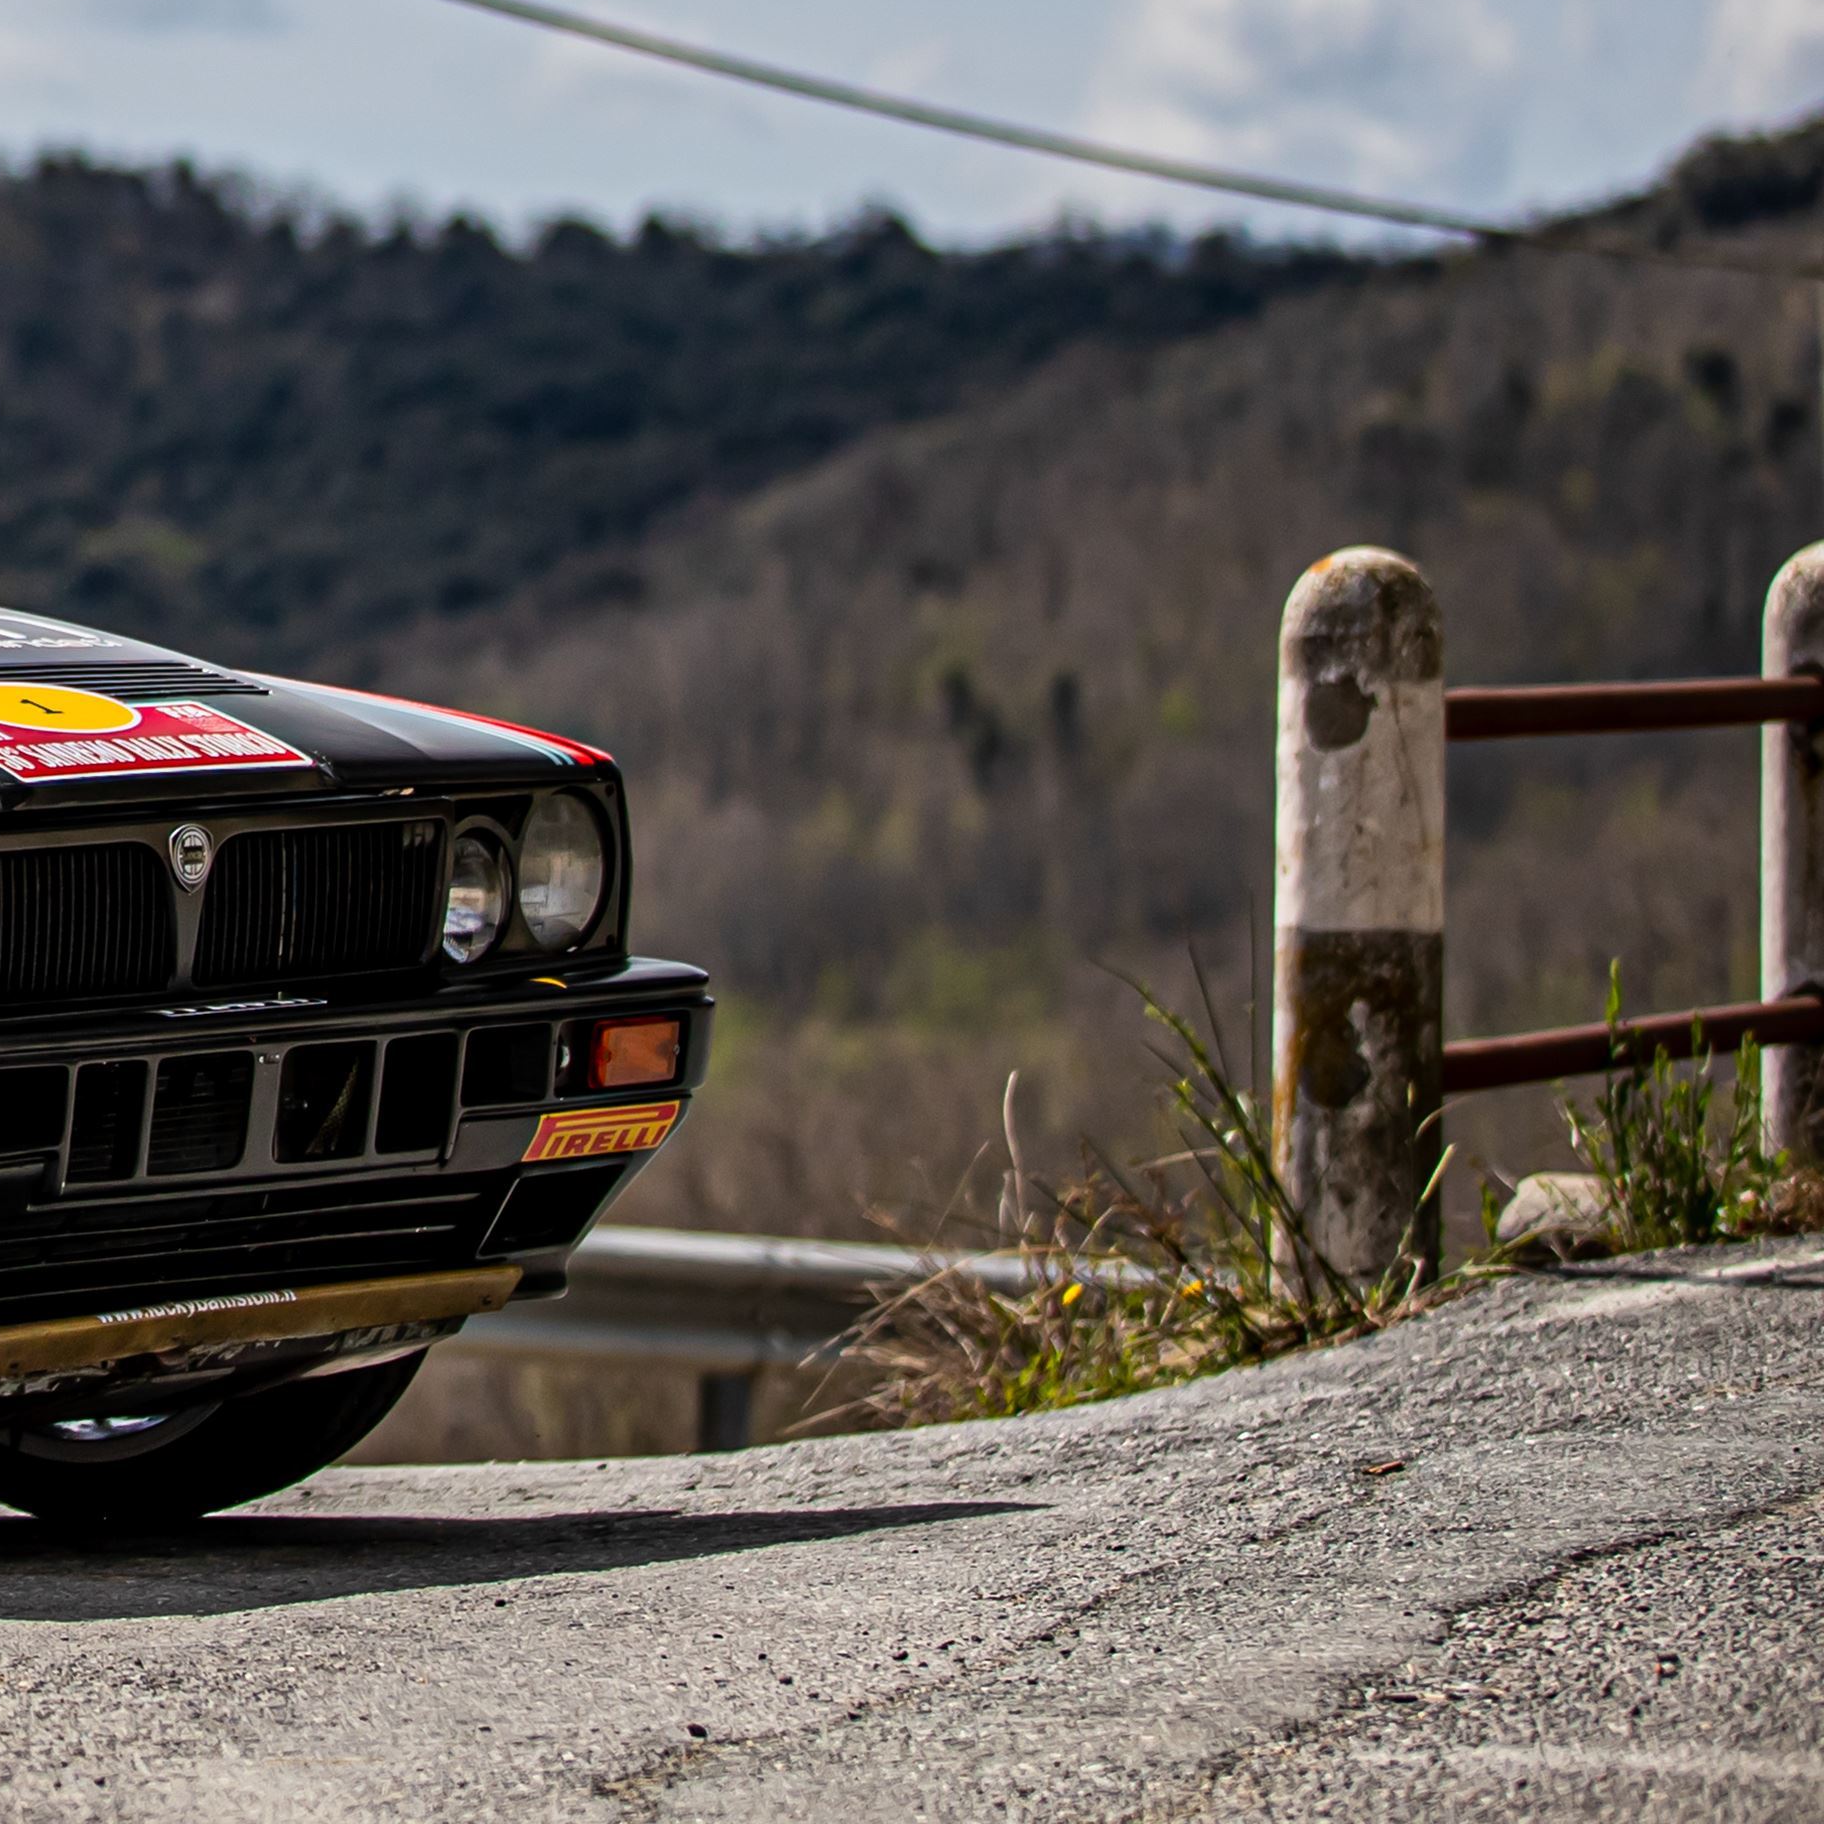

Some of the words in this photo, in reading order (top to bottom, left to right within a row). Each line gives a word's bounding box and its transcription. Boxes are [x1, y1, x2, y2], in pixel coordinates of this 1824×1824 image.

[24, 737, 131, 768] SANREMO
[121, 733, 202, 762] RALLY
[194, 732, 288, 757] STORICO
[519, 1102, 680, 1160] PIRELLI
